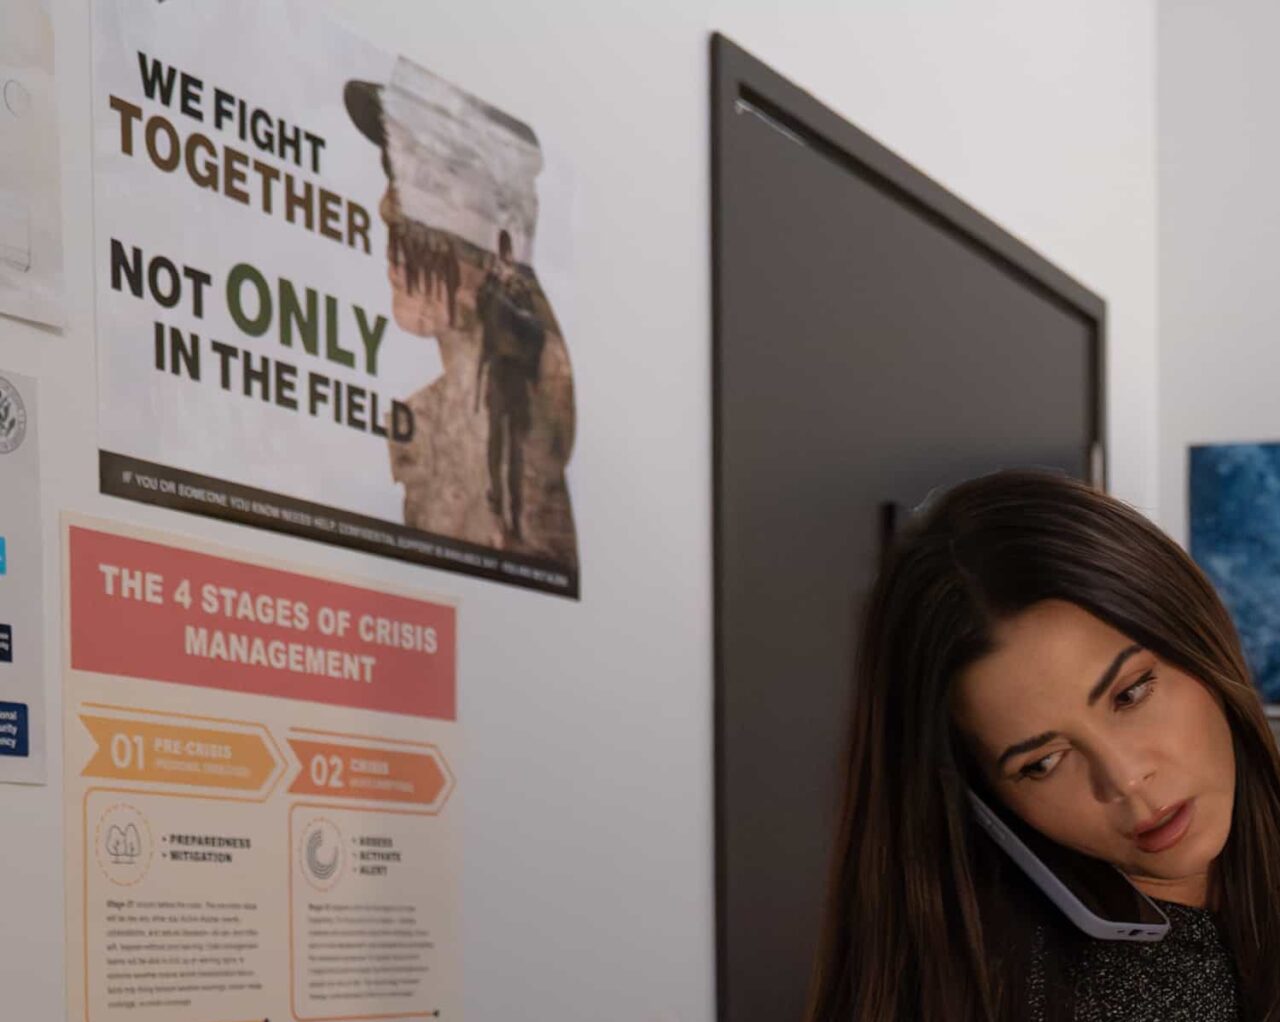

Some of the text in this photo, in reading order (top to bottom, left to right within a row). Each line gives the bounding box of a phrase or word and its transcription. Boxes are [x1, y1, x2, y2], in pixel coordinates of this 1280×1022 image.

[137, 50, 326, 174] WE FIGHT
[109, 94, 372, 255] TOGETHER
[111, 237, 388, 377] NOT ONLY
[154, 321, 416, 444] IN THE FIELD
[135, 474, 158, 491] YOU
[159, 478, 176, 494] OR
[178, 483, 229, 508] SOMEONE
[99, 563, 438, 654] THE 4 STAGES OF CRISIS
[185, 625, 376, 683] MANAGEMENT
[110, 732, 145, 771] 01
[153, 737, 232, 759] PRE-CRISIS
[310, 754, 345, 789] 02
[169, 834, 252, 849] PREPAREDNESS
[170, 851, 233, 863] MITIGATION
